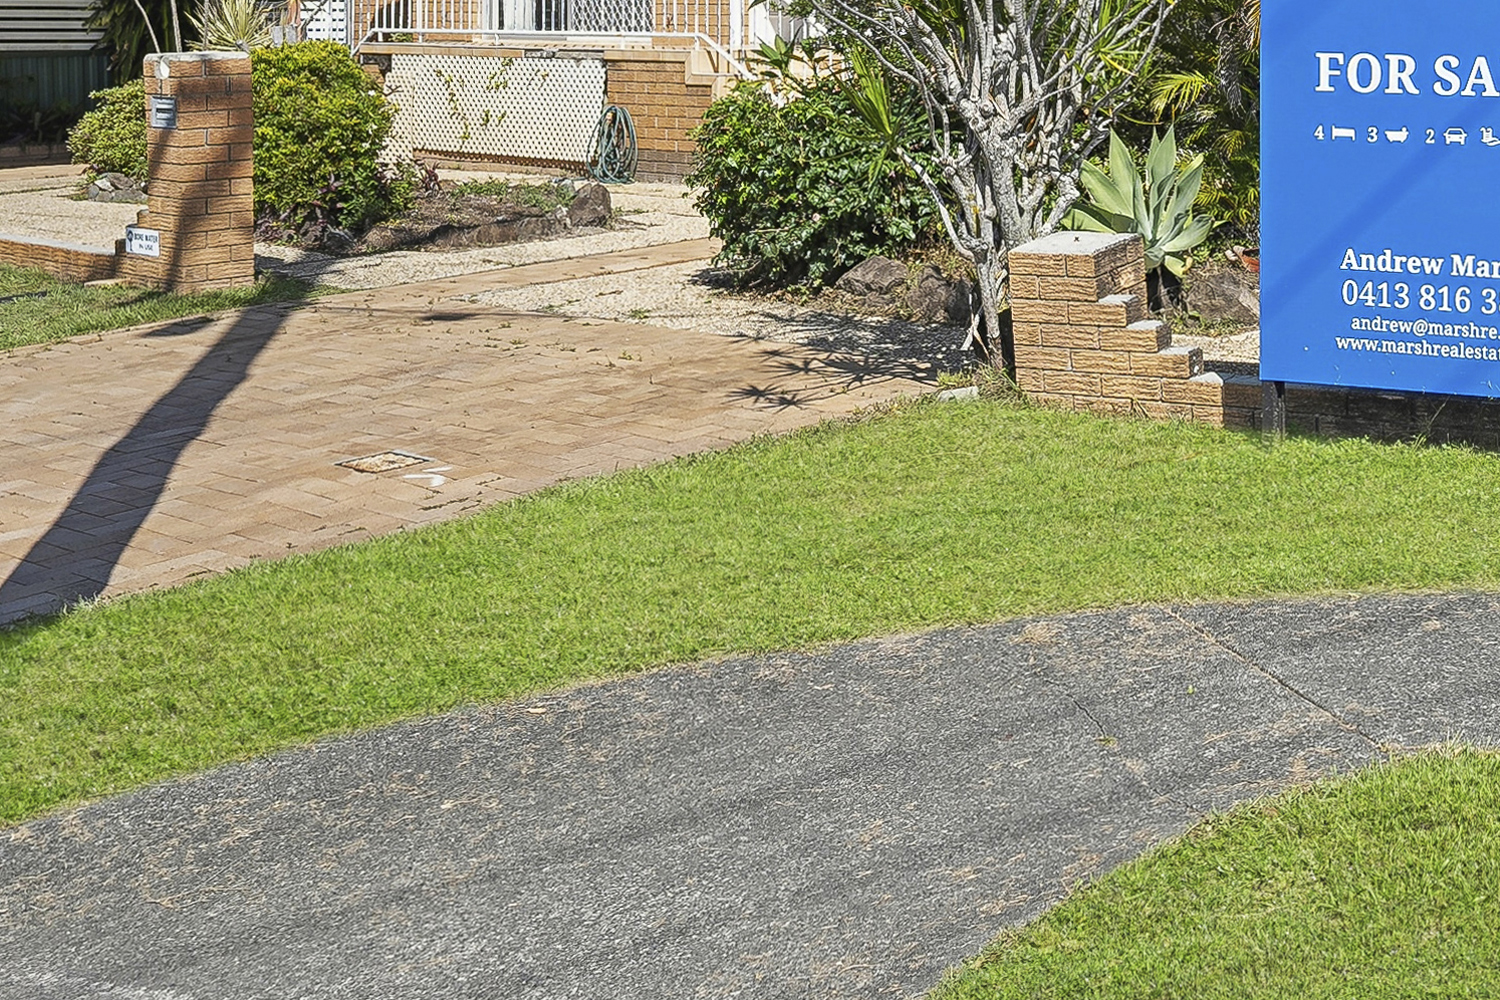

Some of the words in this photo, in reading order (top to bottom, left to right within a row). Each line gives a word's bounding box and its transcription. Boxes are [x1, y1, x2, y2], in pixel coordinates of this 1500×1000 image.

[1315, 52, 1420, 95] FOR
[1313, 125, 1325, 141] 4
[1367, 126, 1379, 143] 3
[1425, 128, 1436, 144] 2
[1339, 248, 1445, 276] Andrew
[1341, 279, 1410, 309] 0413
[1419, 284, 1472, 313] 816
